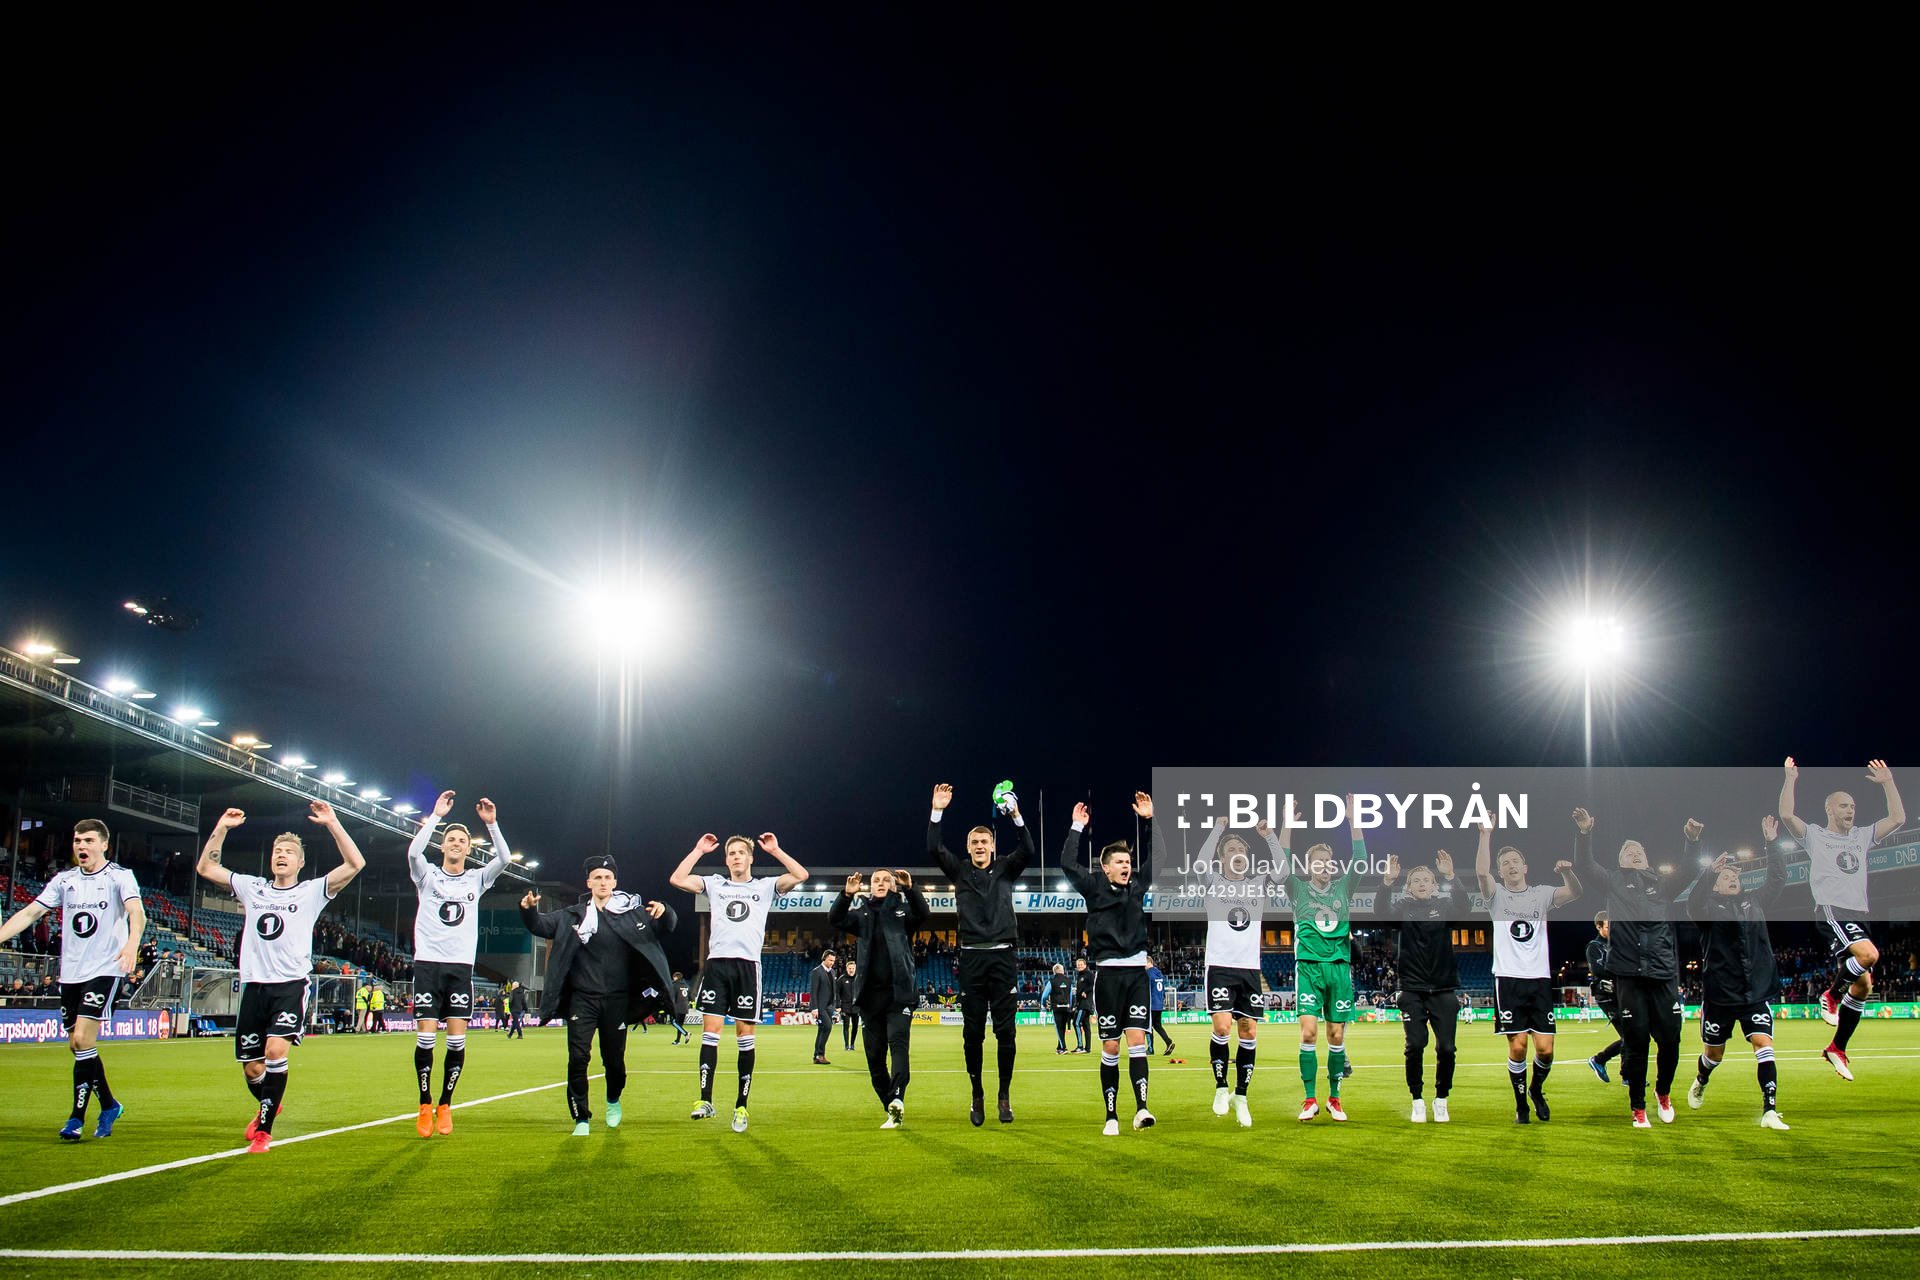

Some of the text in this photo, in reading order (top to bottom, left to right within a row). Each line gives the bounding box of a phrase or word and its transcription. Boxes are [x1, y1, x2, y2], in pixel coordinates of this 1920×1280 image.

[1895, 847, 1918, 865] DNB
[116, 1018, 133, 1036] mai
[148, 1018, 158, 1036] 18
